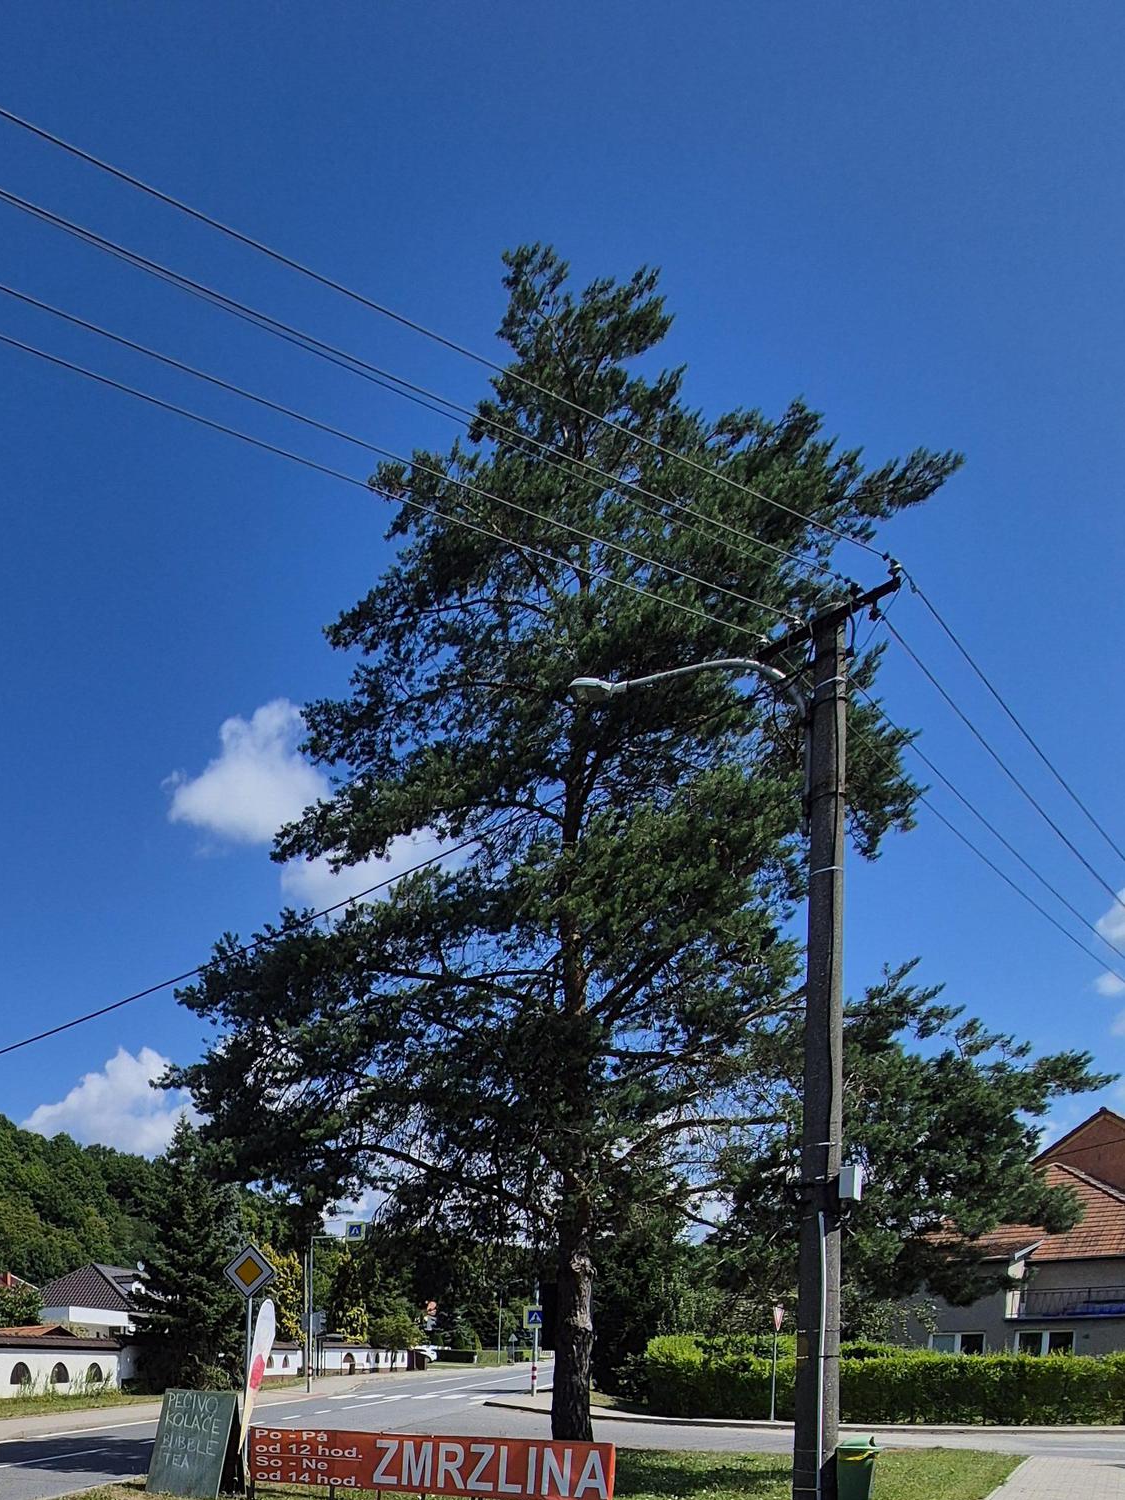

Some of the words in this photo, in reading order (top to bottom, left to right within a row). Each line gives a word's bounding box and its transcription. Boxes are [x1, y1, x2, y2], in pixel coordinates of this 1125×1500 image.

[167, 1391, 219, 1413] PEČIVO
[165, 1410, 221, 1435] KOLÁČE
[255, 1429, 282, 1440] Po
[302, 1431, 328, 1442] Pá
[255, 1443, 281, 1453] od
[288, 1444, 311, 1455] 12
[317, 1445, 363, 1458] hod.
[163, 1452, 189, 1469] TEA
[256, 1456, 282, 1467] So
[302, 1459, 328, 1470] Ne
[372, 1439, 608, 1500] ZMRZLINA
[256, 1470, 281, 1481] od
[288, 1472, 311, 1482] 14
[317, 1473, 362, 1487] hod.
